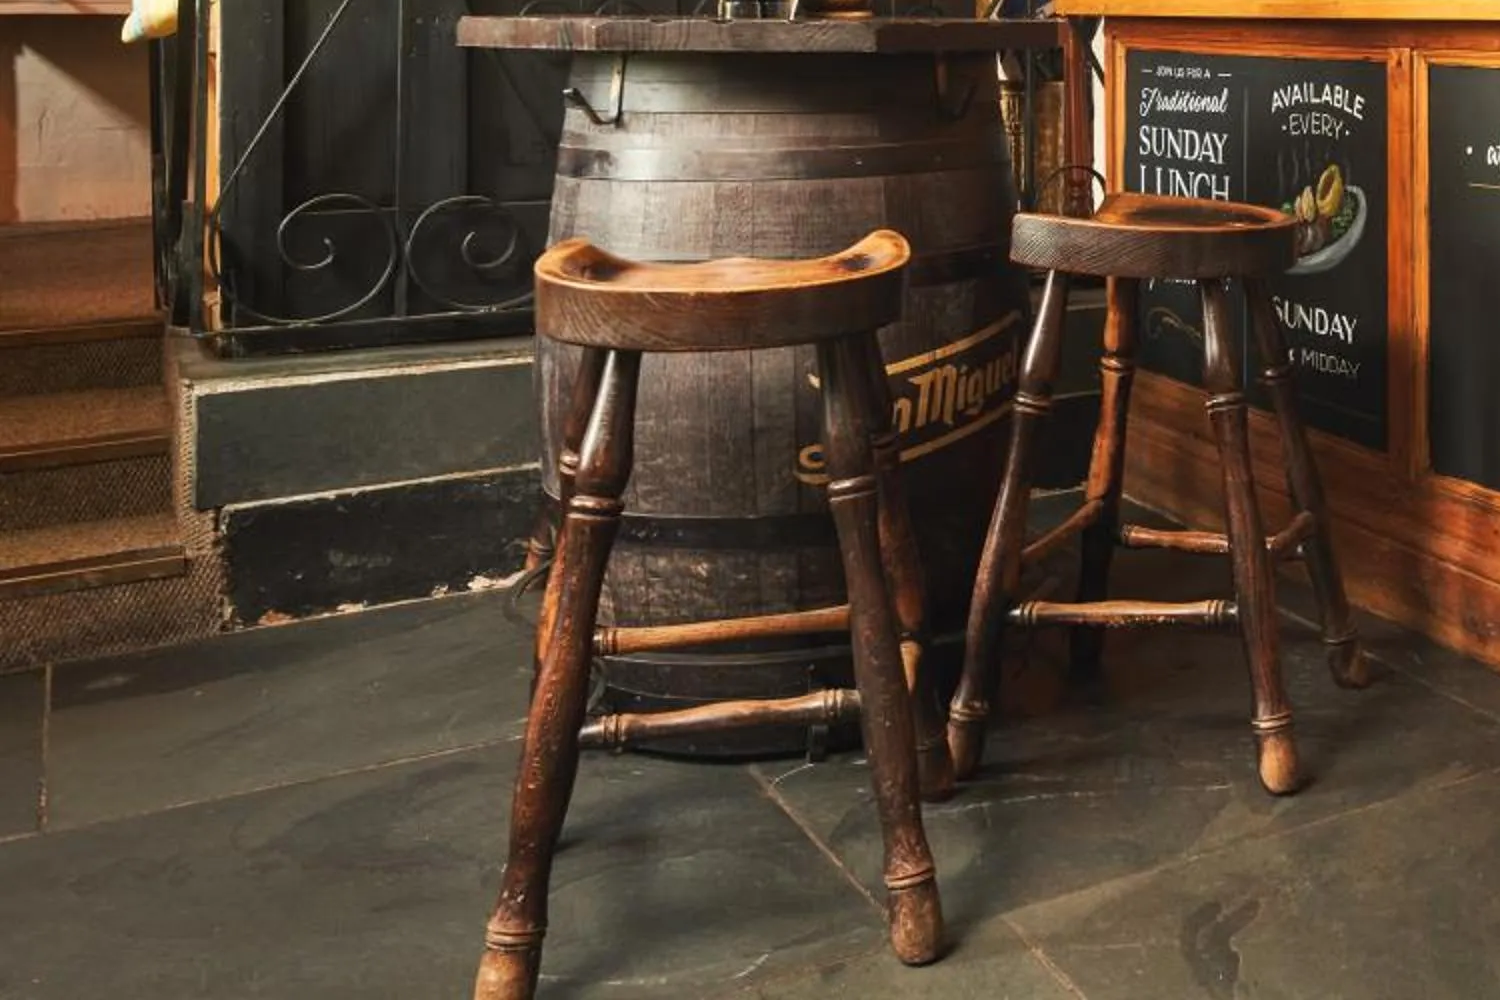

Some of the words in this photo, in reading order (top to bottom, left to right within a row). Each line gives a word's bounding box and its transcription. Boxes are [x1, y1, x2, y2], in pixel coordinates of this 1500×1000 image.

[1139, 86, 1229, 117] Traditional
[1271, 82, 1365, 120] AVAILABLE
[1288, 112, 1343, 140] EVERY
[1139, 124, 1229, 165] SUNDAY
[1271, 296, 1358, 345] SUNDAY
[1301, 349, 1361, 378] MIDDAY
